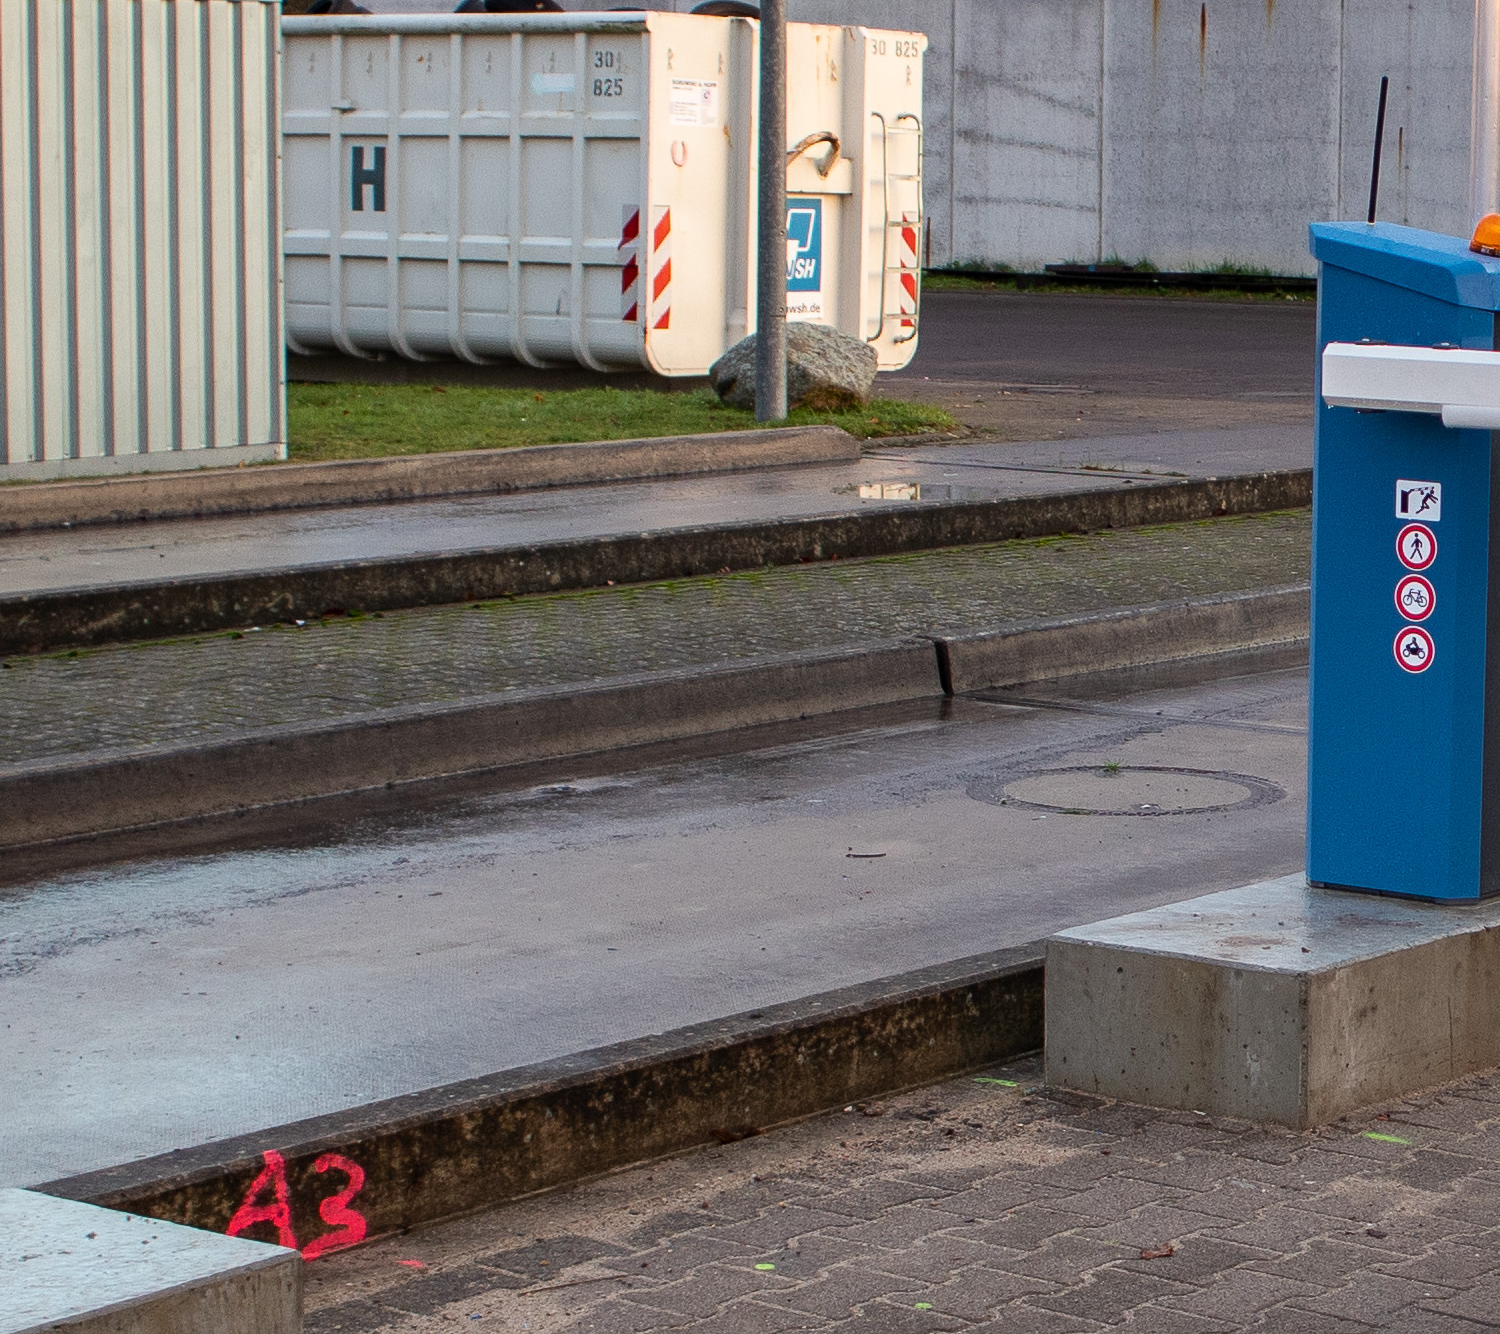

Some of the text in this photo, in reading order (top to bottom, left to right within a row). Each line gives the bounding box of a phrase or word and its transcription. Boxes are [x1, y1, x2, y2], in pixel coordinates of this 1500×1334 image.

[870, 38, 919, 58] 30 825
[593, 50, 614, 69] 30
[593, 78, 623, 97] 825
[351, 145, 386, 212] H
[226, 1149, 367, 1263] A3
